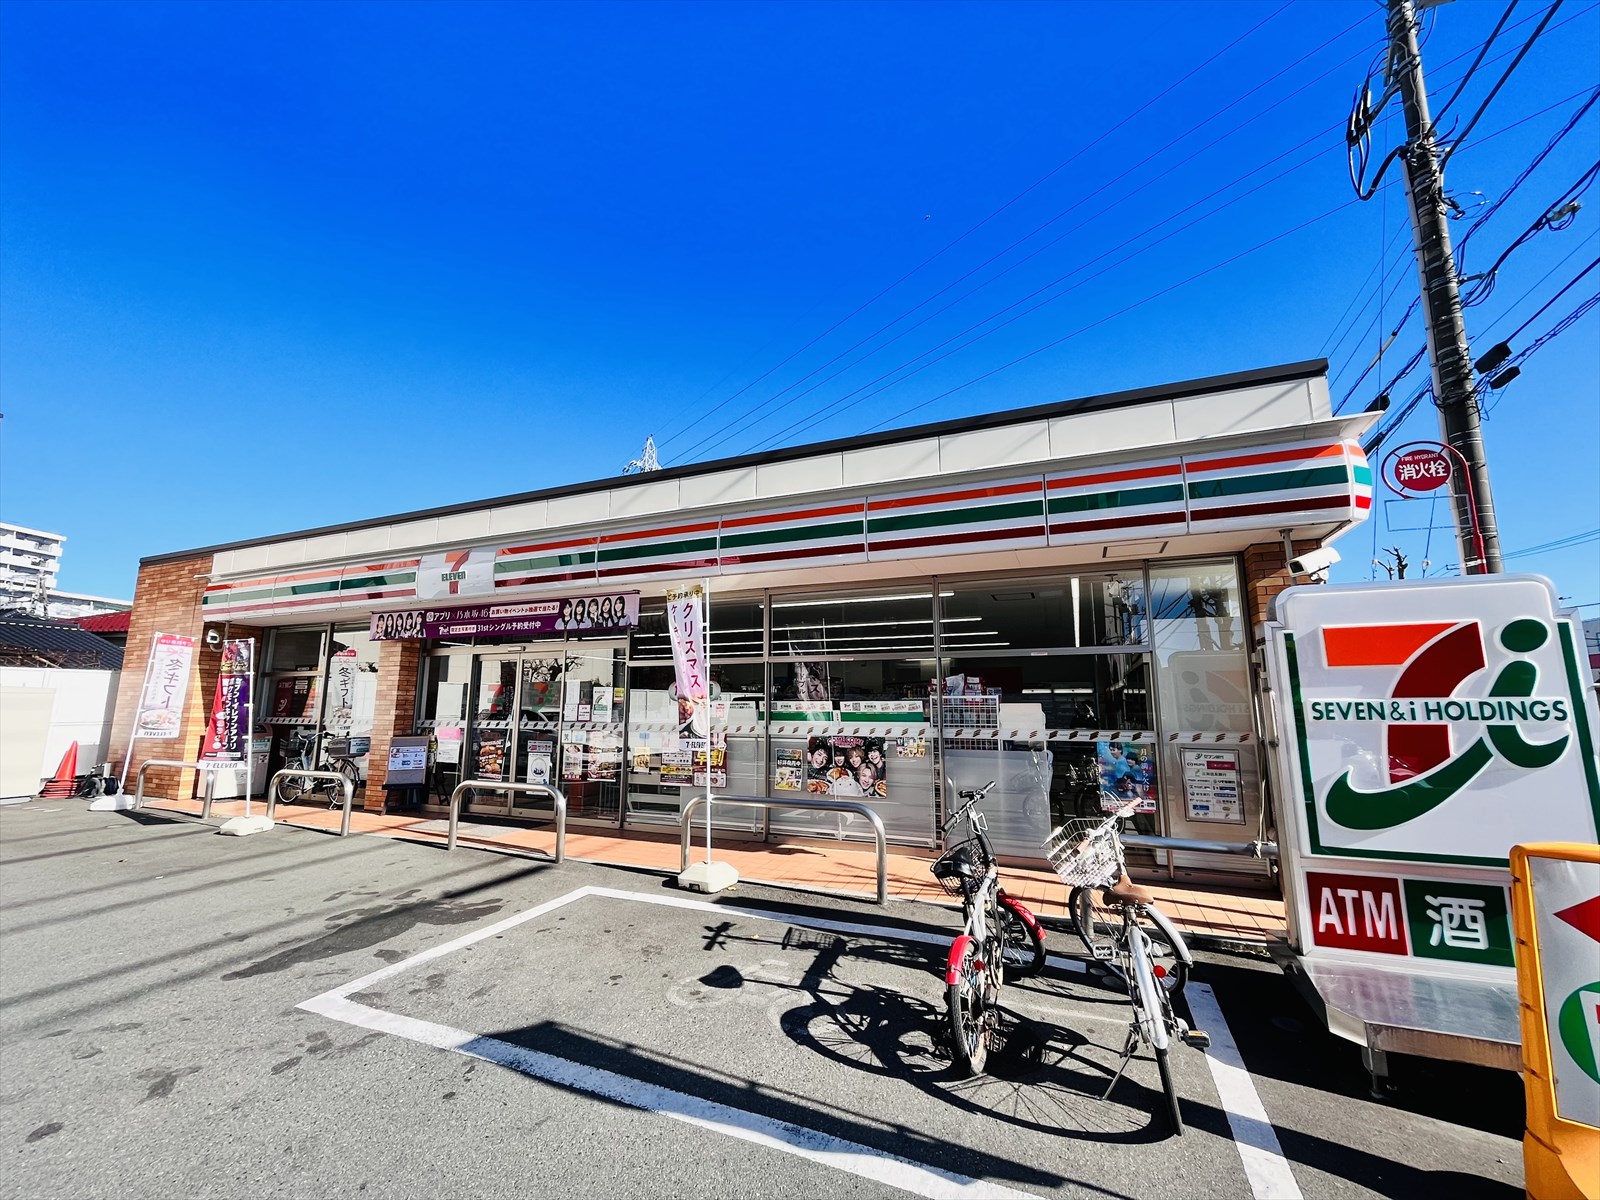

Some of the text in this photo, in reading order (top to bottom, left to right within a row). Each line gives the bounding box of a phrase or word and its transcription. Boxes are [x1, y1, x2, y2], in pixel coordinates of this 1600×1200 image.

[1398, 459, 1448, 481] 消火栓
[683, 602, 701, 689] クリスマス
[1425, 700, 1568, 721] HOLDINGS
[1318, 887, 1399, 940] ATM
[1424, 894, 1489, 950] 酒
